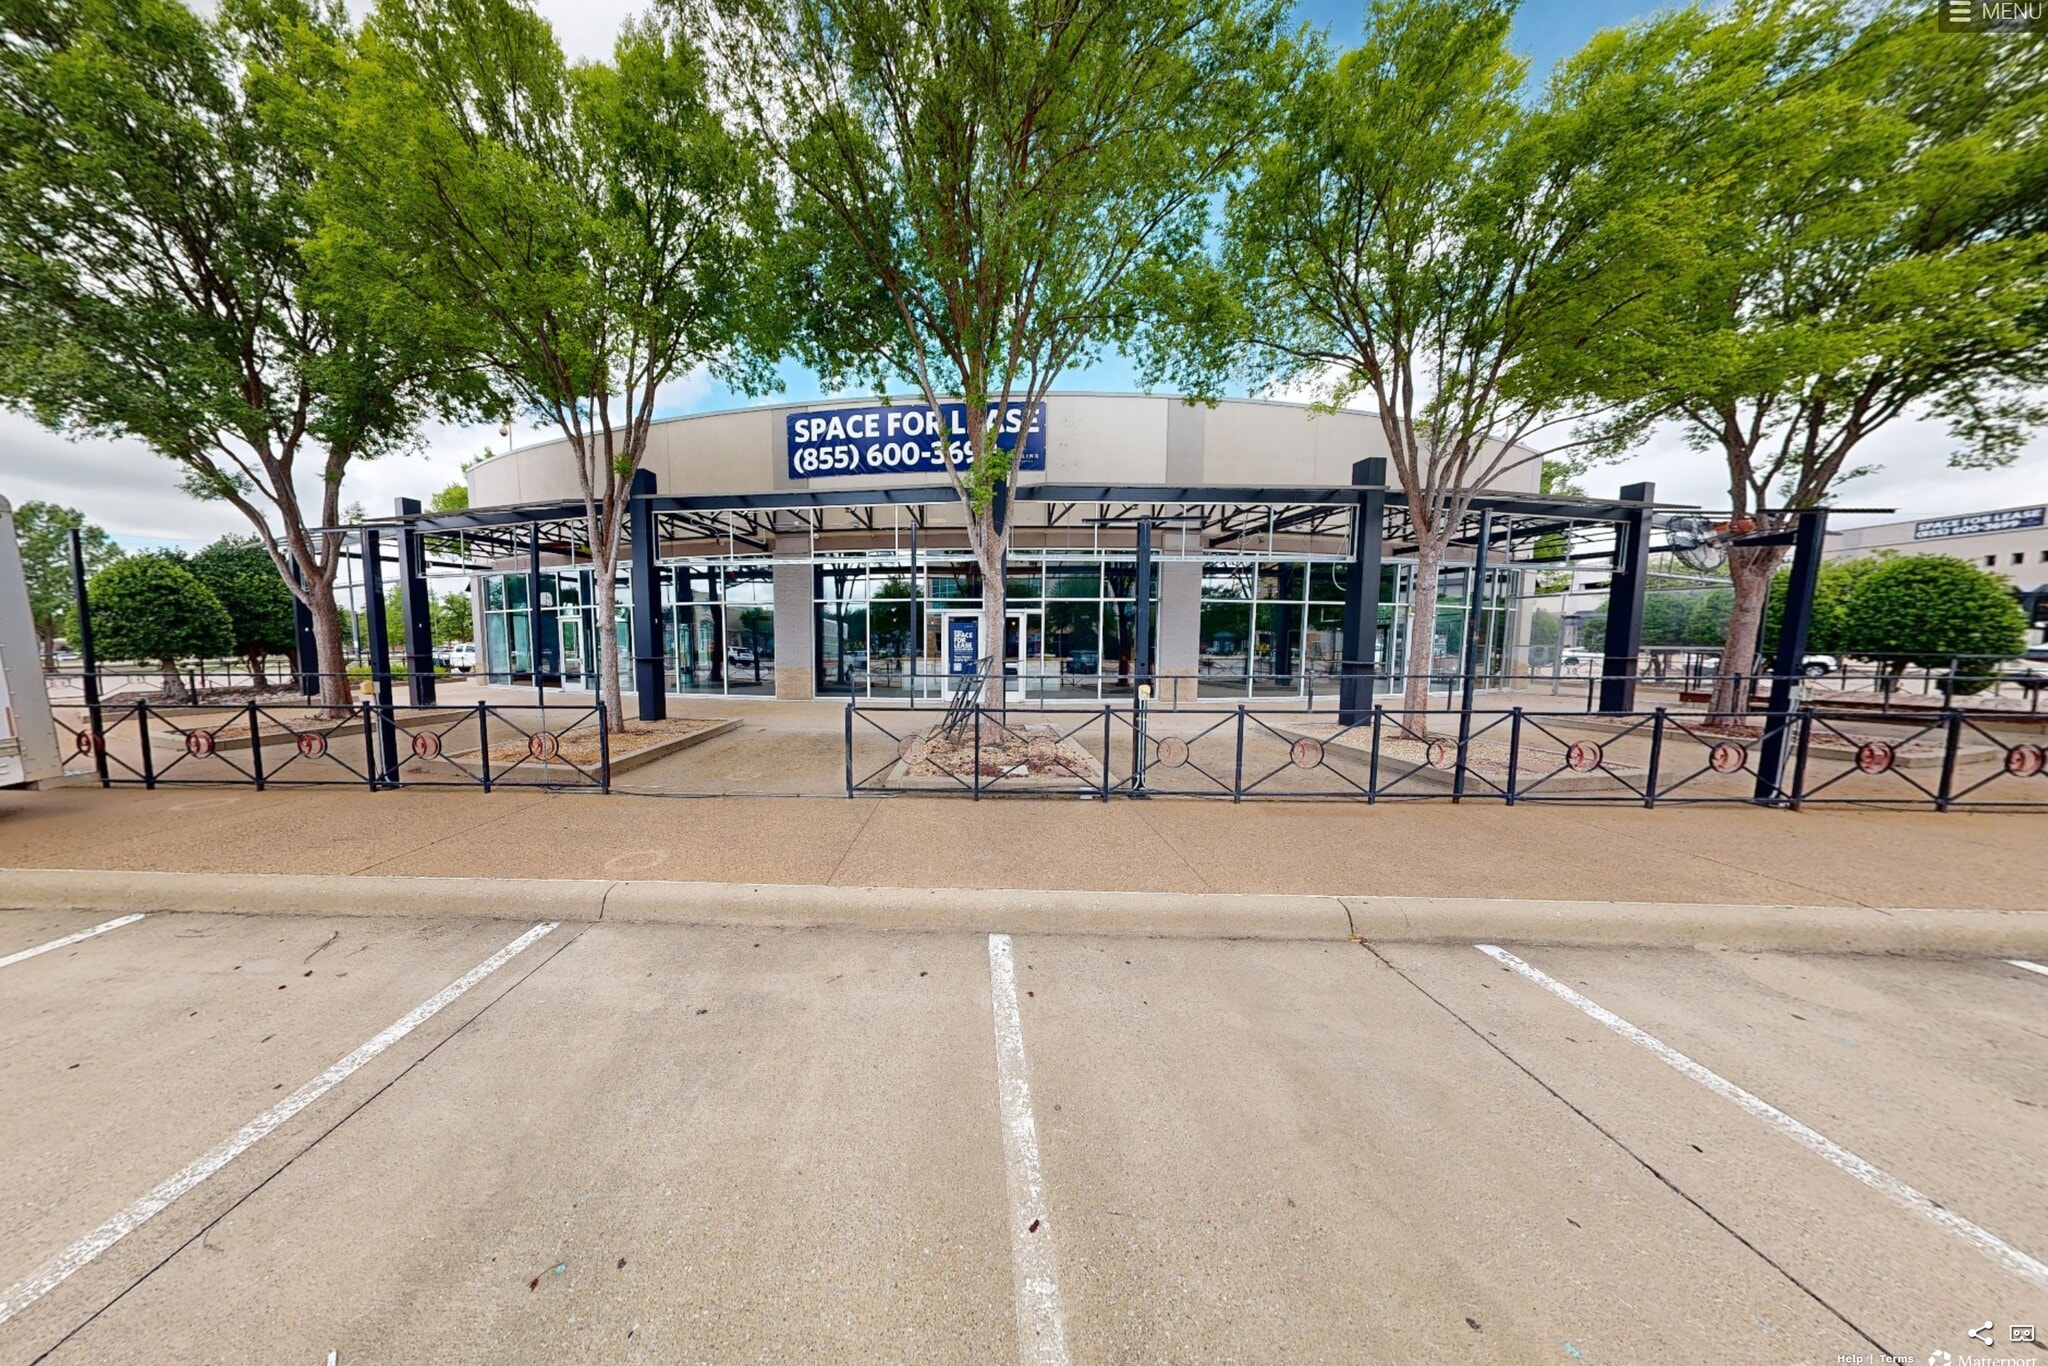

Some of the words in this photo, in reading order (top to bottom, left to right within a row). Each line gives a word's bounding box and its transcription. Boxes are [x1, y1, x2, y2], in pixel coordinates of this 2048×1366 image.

[794, 413, 880, 443] SPACE
[887, 411, 941, 436] FOR
[951, 408, 1040, 434] LASE
[793, 444, 860, 474] (855)
[866, 440, 998, 467] 600-369
[1915, 527, 1949, 538] (855)
[1952, 520, 2021, 533] 600-3699
[1918, 519, 1960, 530] SPACE
[1963, 516, 1992, 526] FOR
[1995, 509, 2042, 520] LEASE
